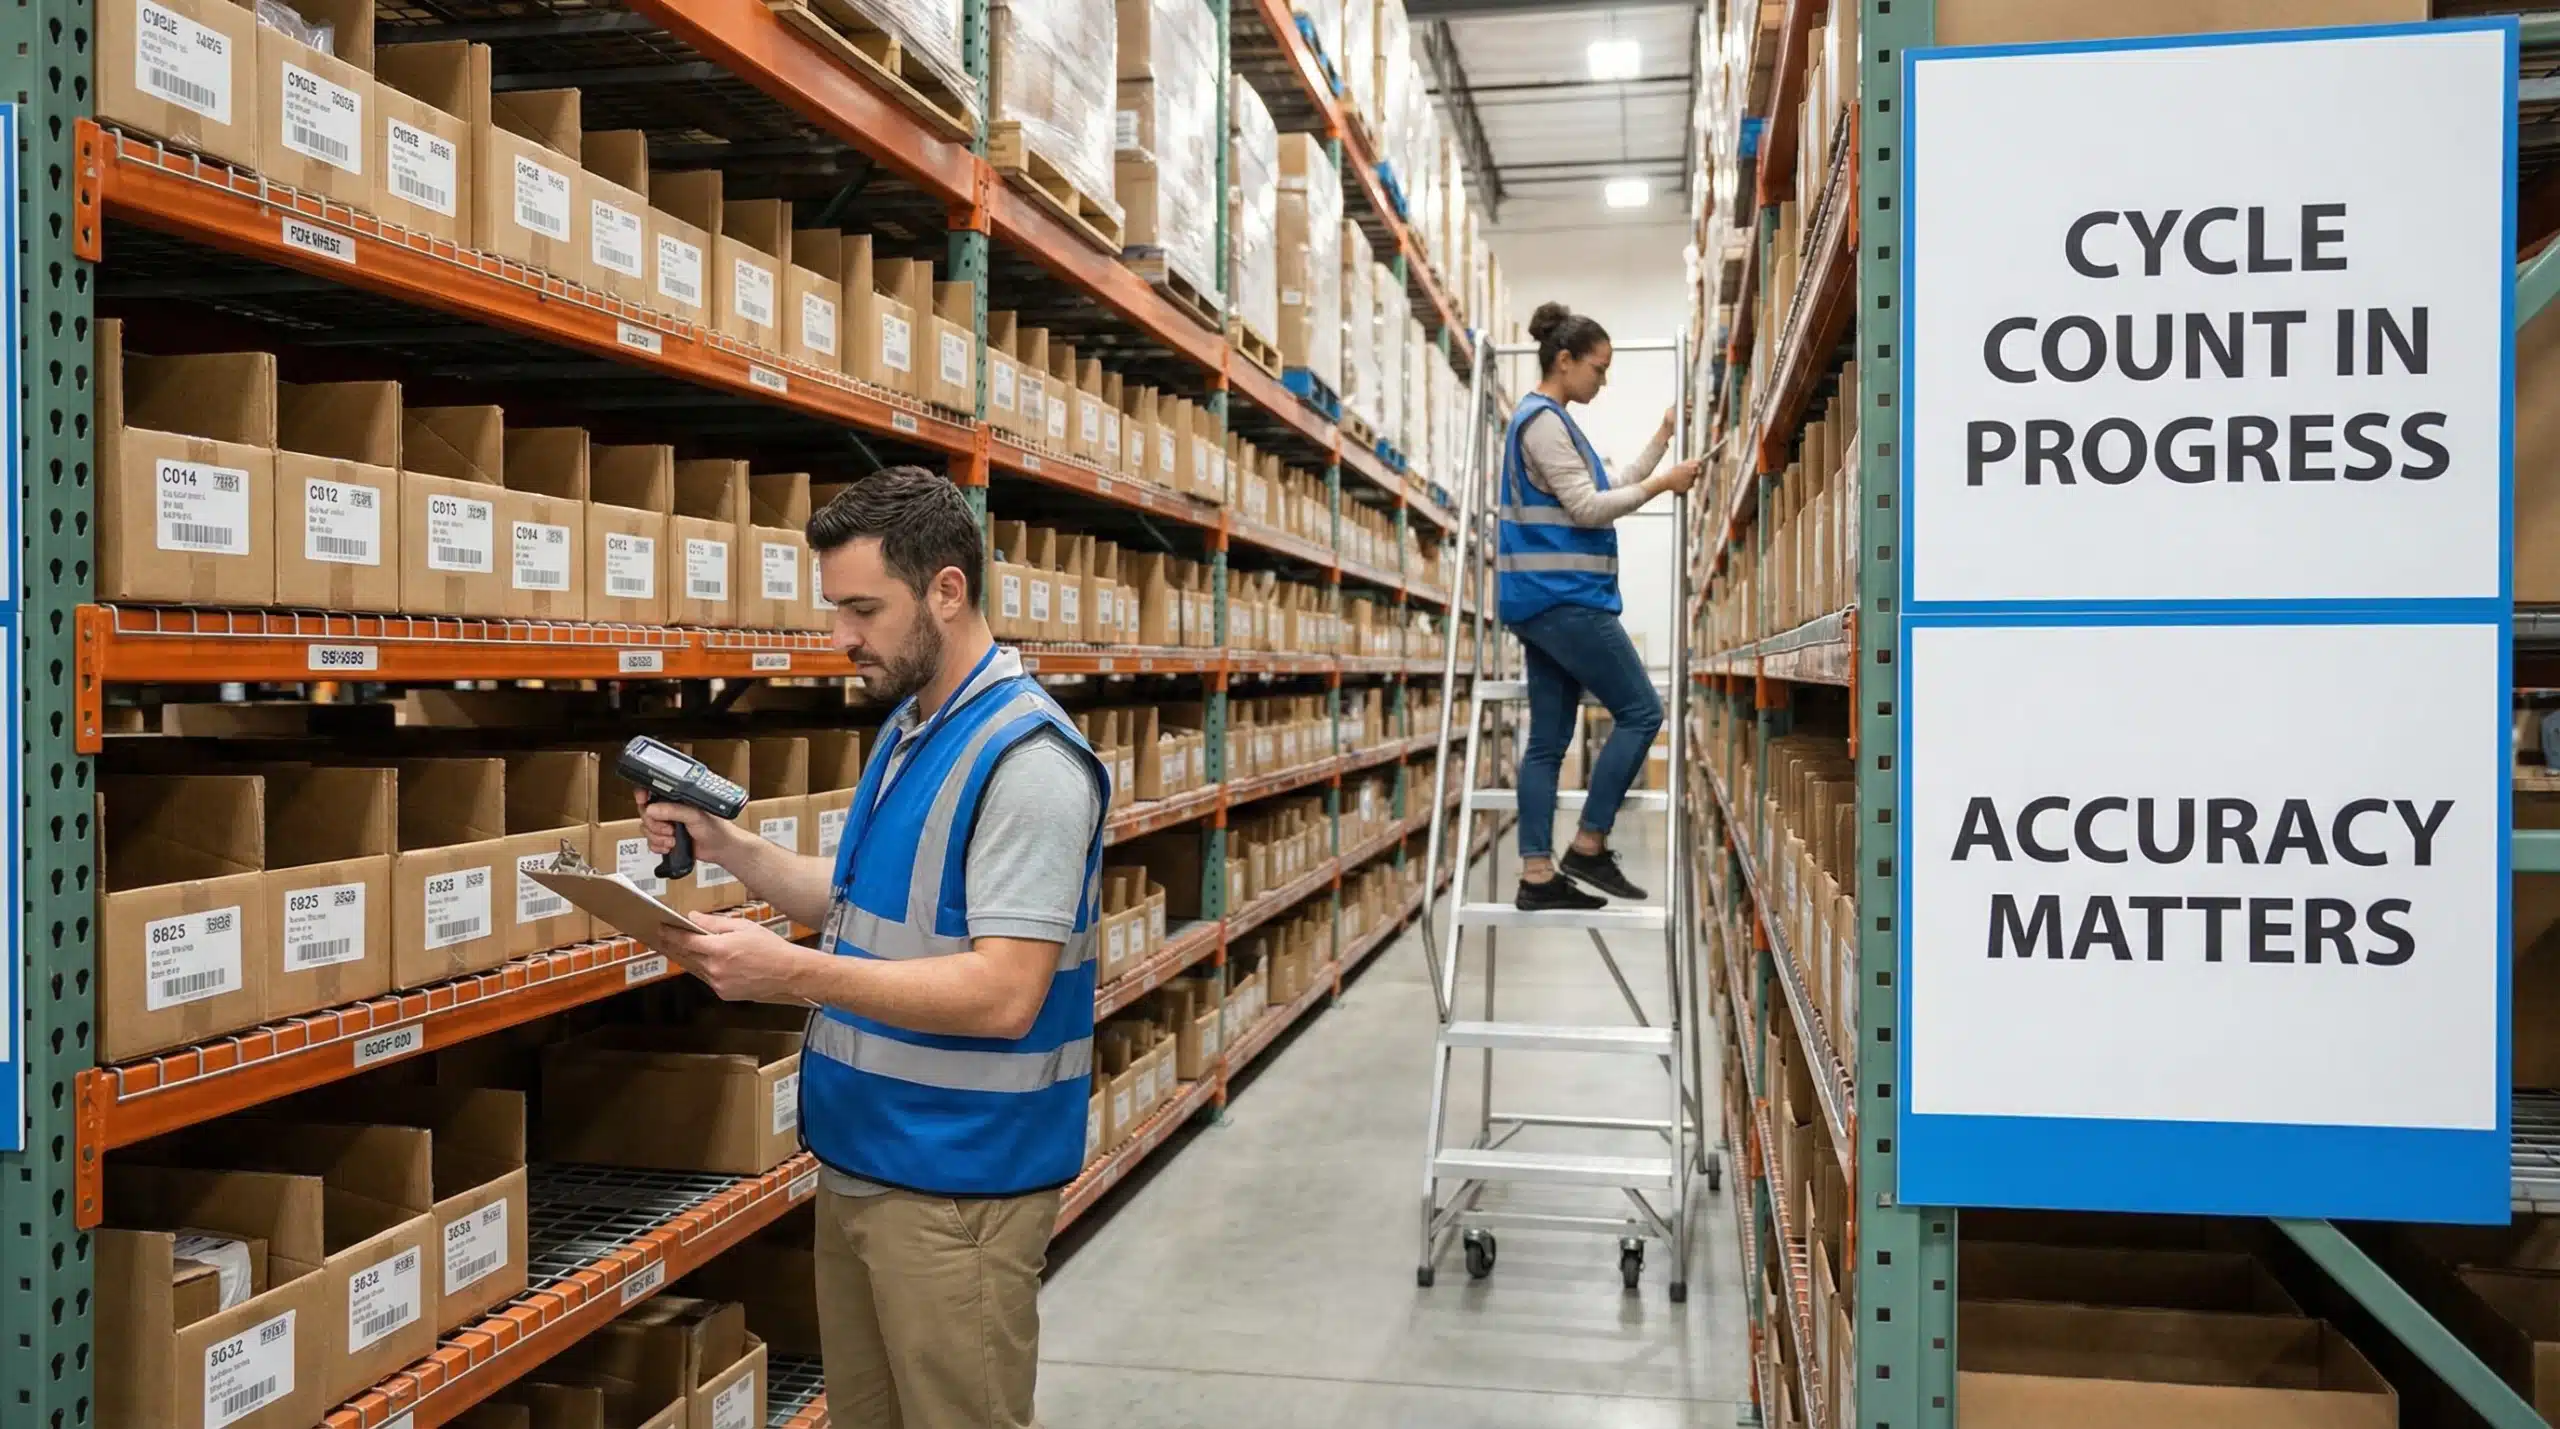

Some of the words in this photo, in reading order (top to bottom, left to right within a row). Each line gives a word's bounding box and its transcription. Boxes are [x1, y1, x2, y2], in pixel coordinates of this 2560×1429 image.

[2065, 203, 2348, 279] CYCLE
[1983, 310, 2307, 383] COUNT
[2336, 306, 2429, 377] IN
[163, 467, 197, 487] C014
[1967, 412, 2450, 486] PROGRESS
[1950, 796, 2456, 867] ACCURACY
[1987, 894, 2416, 967] MATTERS
